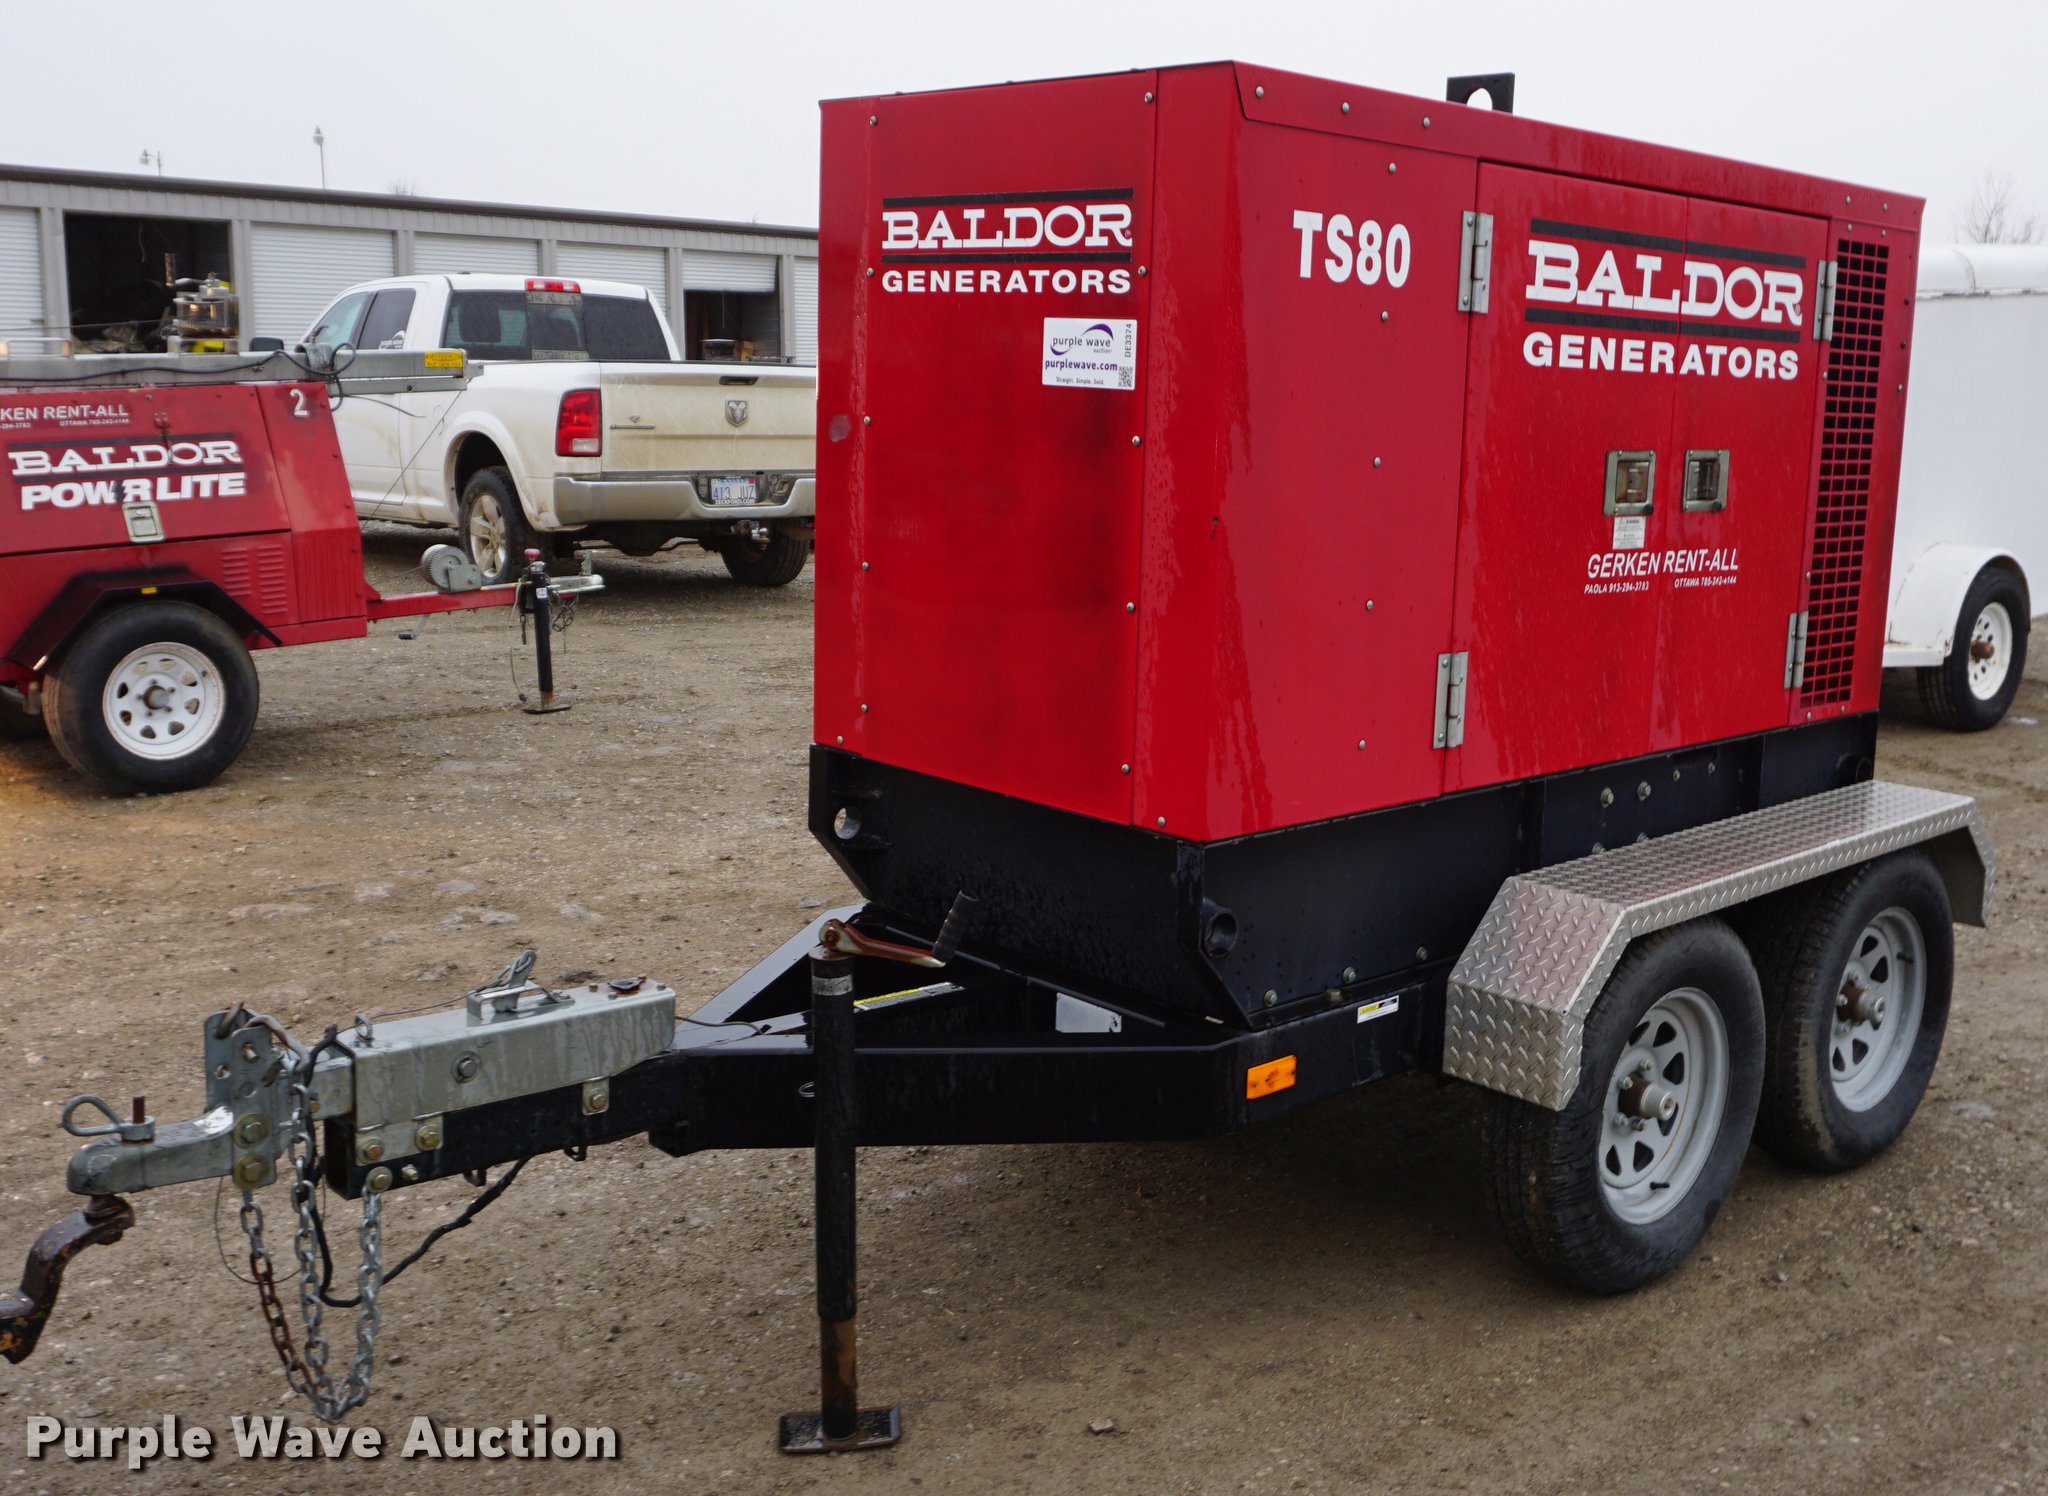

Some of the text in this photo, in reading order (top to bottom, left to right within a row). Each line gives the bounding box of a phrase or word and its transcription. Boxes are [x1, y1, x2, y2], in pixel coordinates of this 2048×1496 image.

[882, 204, 1133, 249] BALDOR
[1293, 209, 1411, 288] TS80
[882, 269, 1131, 293] GENERATORS
[1525, 239, 1804, 327] BALDOR
[1053, 336, 1111, 347] purple wave
[1124, 323, 1132, 358] DE3374
[1523, 331, 1799, 380] GENERATORS
[1045, 358, 1118, 371] purplewave.com
[43, 404, 129, 419] RENT-ALL
[289, 388, 308, 416] 2
[8, 440, 242, 476] BALDOR
[1588, 548, 1739, 578] GERKEN RENT-ALL
[1584, 583, 1607, 594] PAOLA
[1675, 578, 1699, 588] OTTAWA
